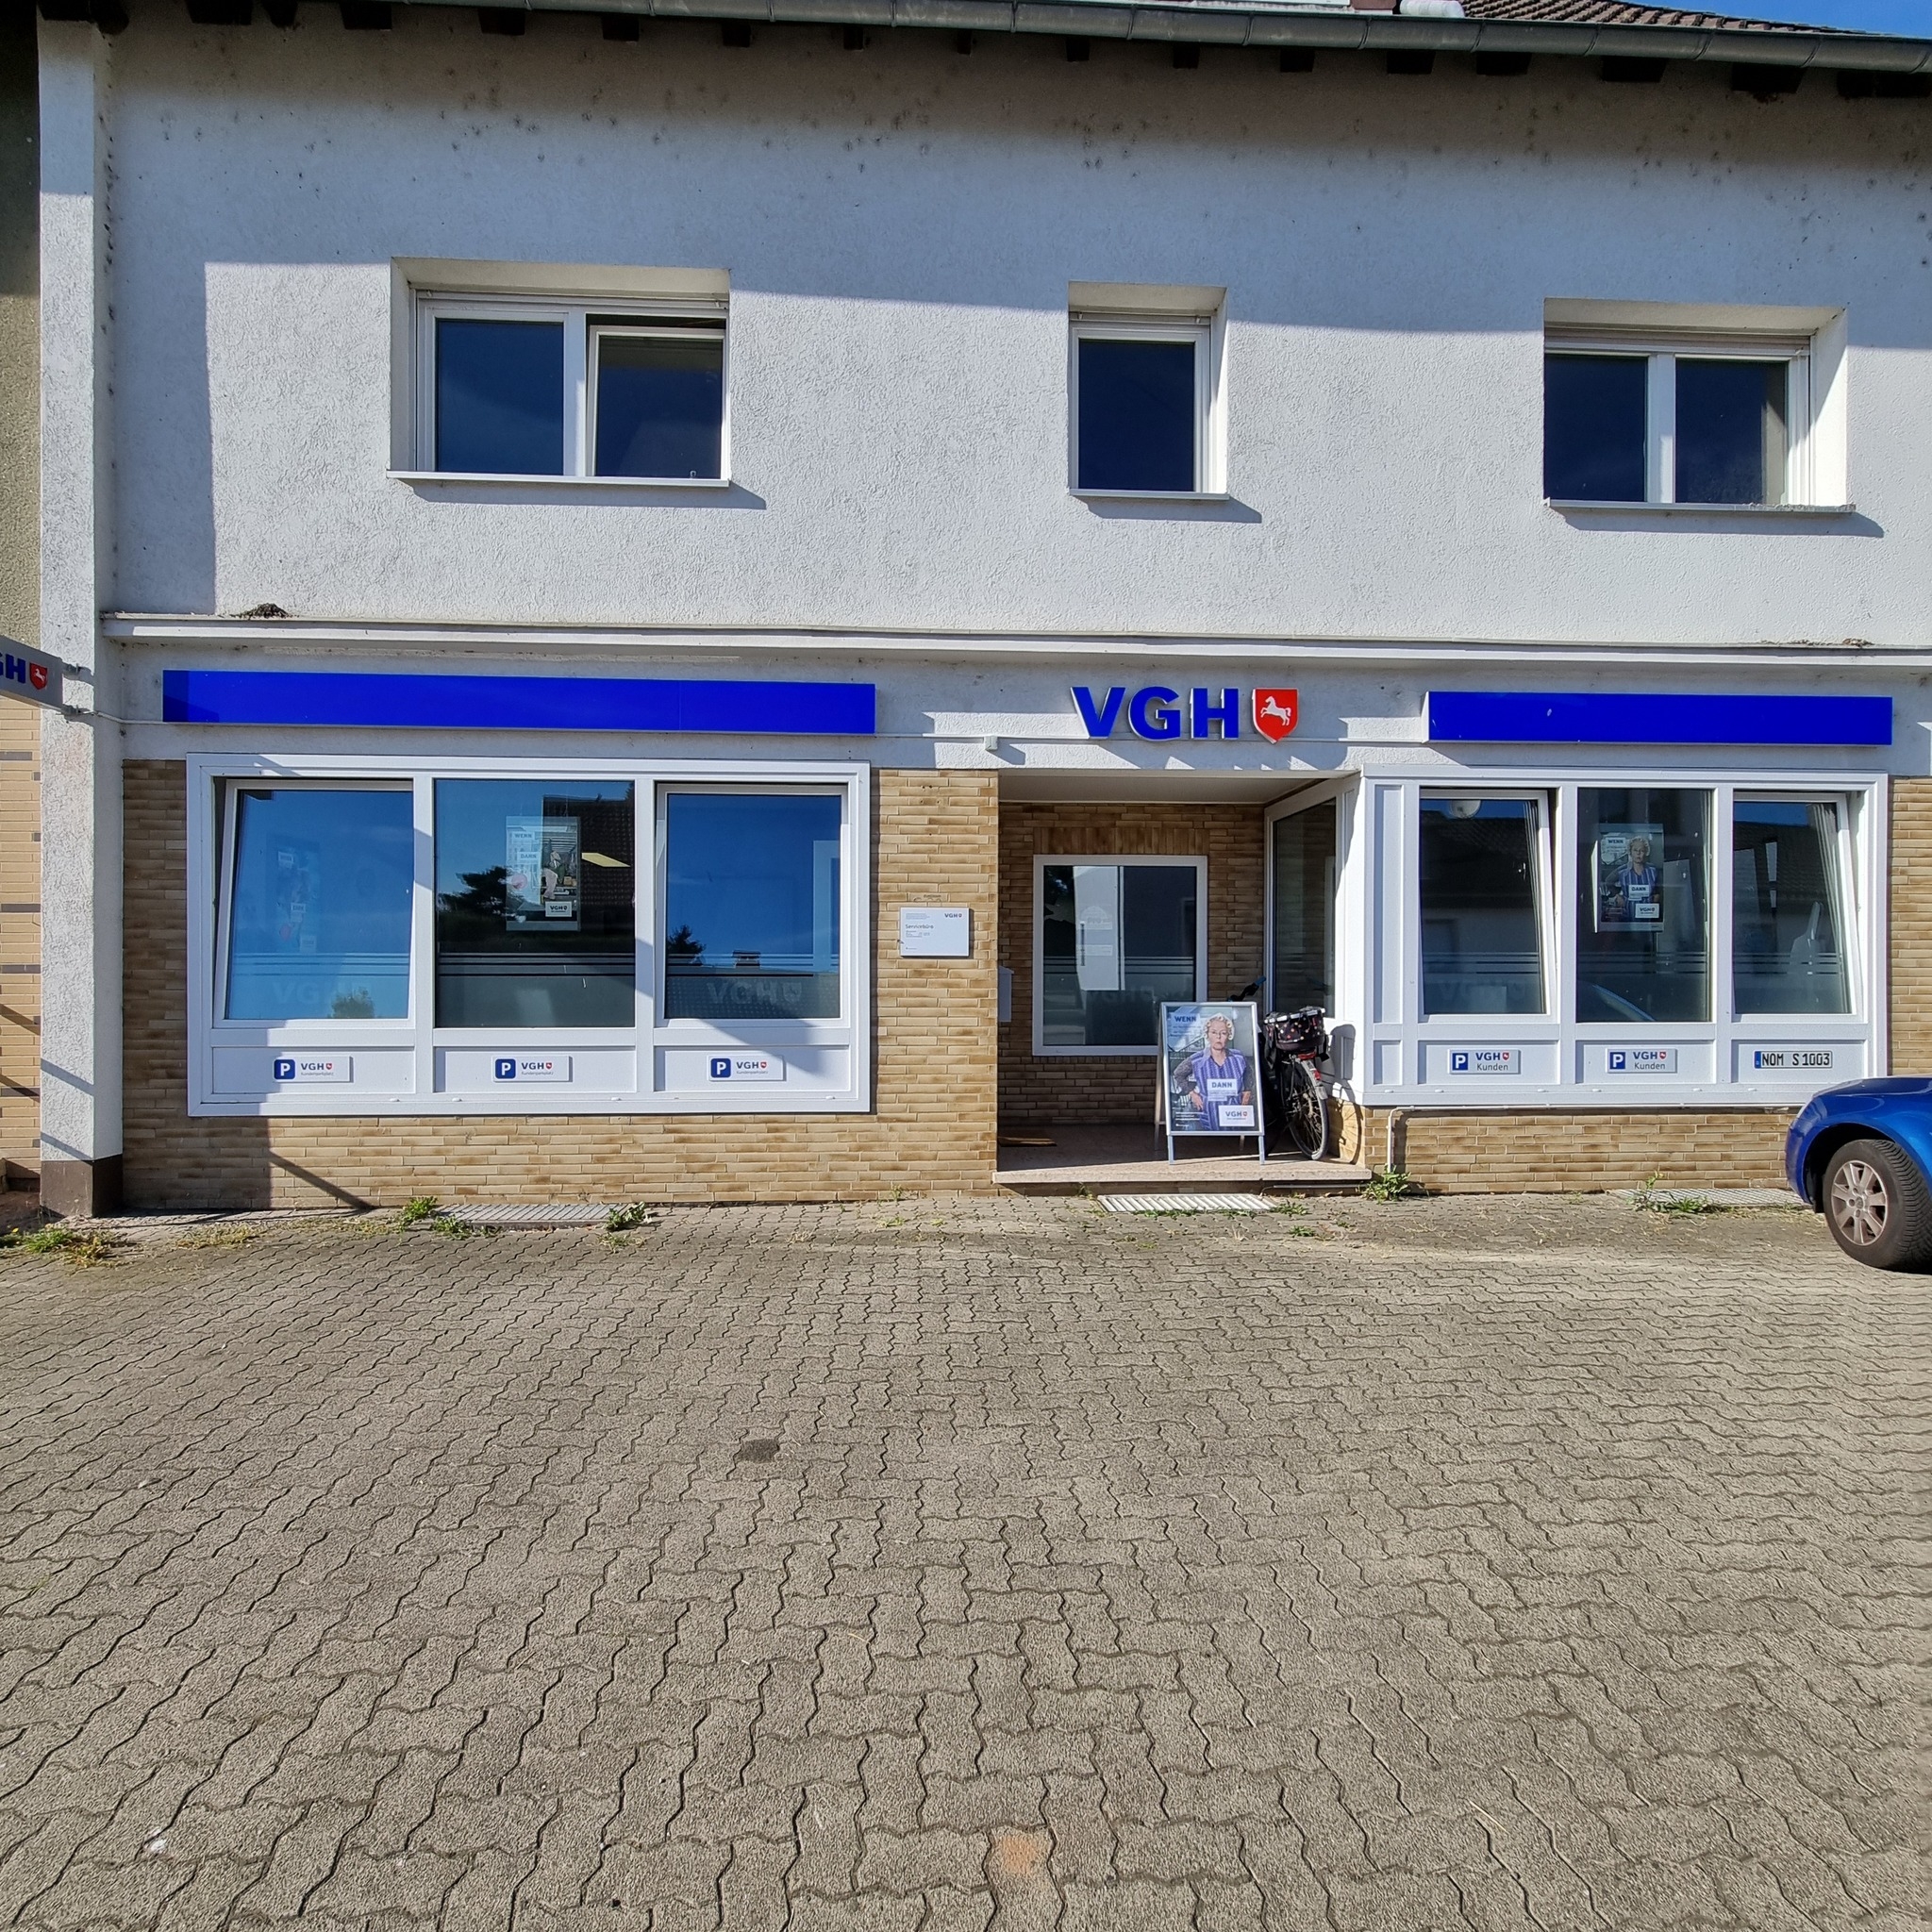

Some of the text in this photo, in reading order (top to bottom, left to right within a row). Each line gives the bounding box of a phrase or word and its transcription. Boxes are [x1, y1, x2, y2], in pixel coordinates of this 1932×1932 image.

[1071, 686, 1241, 741] VGH
[1455, 1052, 1501, 1070] P VGH
[1612, 1051, 1657, 1068] P VGH
[1761, 1053, 1784, 1066] NOM
[280, 1062, 325, 1076] P VGH
[501, 1062, 512, 1076] P
[716, 1061, 760, 1075] P VGH
[1476, 1063, 1509, 1072] Kunden
